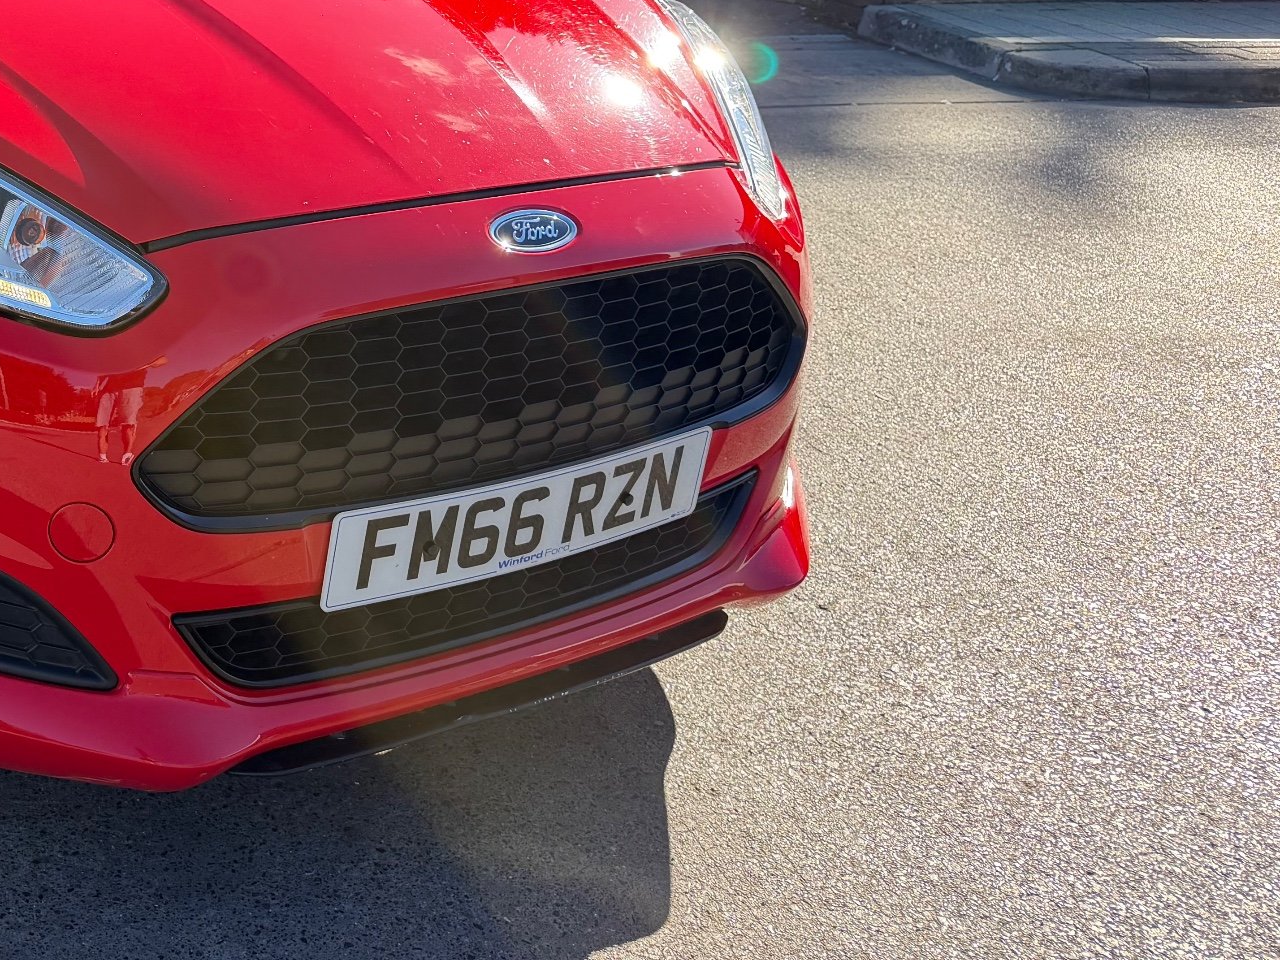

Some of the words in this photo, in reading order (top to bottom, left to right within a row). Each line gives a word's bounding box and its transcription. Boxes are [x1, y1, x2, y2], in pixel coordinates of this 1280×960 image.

[512, 217, 558, 242] Ford
[356, 486, 550, 591] FM66
[561, 445, 685, 545] RZN
[498, 550, 544, 569] Winford
[544, 544, 570, 557] Ford
